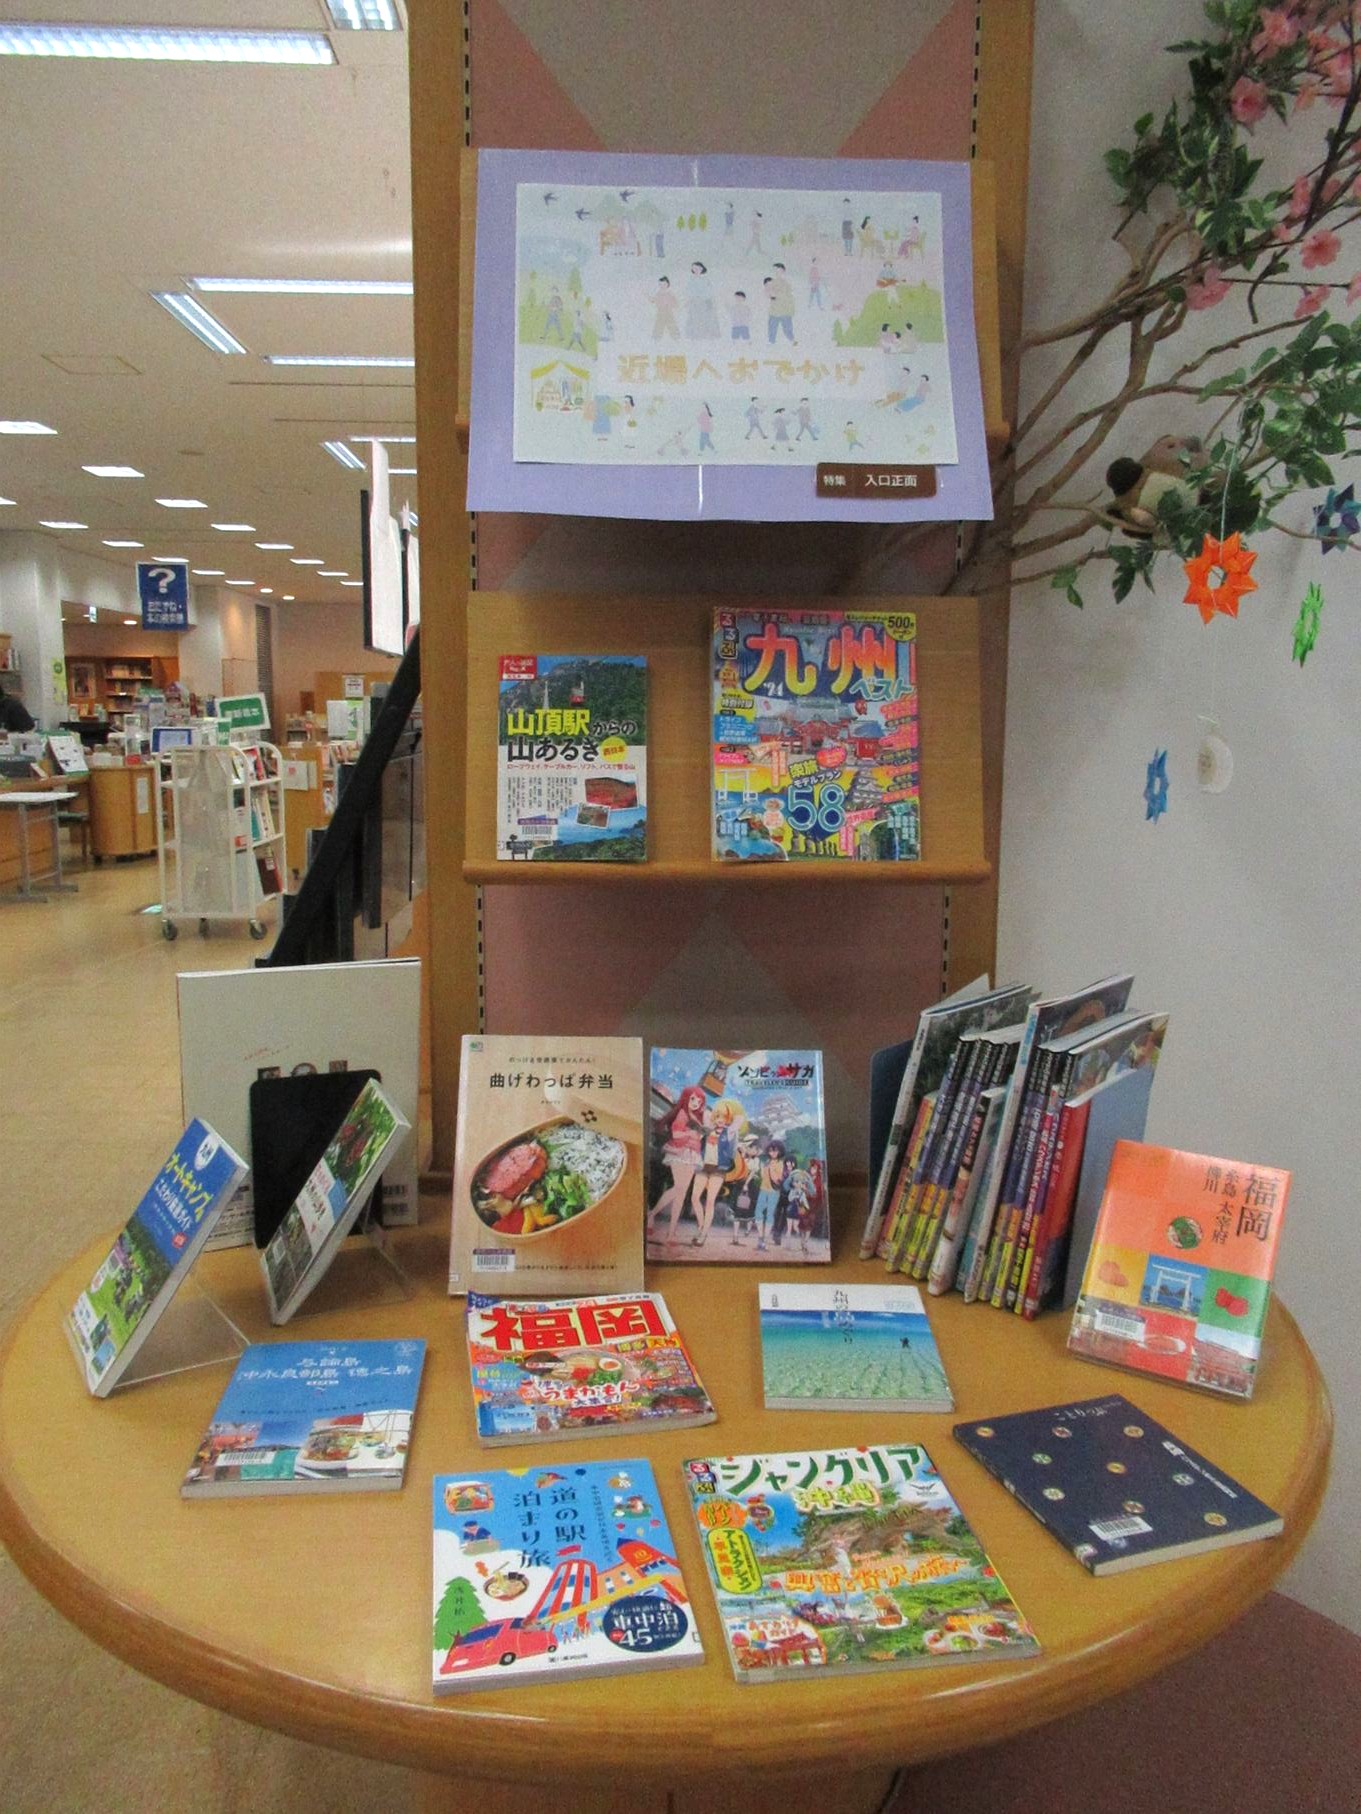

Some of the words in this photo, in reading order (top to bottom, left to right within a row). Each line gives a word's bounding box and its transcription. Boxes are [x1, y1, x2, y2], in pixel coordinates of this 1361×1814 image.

[618, 353, 865, 385] 近場へおでかけ
[823, 475, 847, 486] 特集
[865, 474, 918, 487] 入口正面
[888, 616, 911, 629] 500
[744, 622, 898, 696] 九州
[850, 677, 914, 700] ベスト
[507, 736, 600, 763] 山あるき
[788, 784, 846, 832] 58
[165, 1152, 215, 1223] オートキャンプ
[1221, 1169, 1240, 1198] 糸島
[1237, 1174, 1279, 1242] 福岡
[480, 1299, 668, 1352] 福岡
[544, 1381, 641, 1400] うまかもん
[721, 1448, 922, 1496] ジャングリア
[794, 1482, 878, 1510] 沖縄
[513, 1490, 551, 1568] 泊まり旅
[551, 1486, 588, 1542] 道の駅
[613, 1612, 680, 1631] 車中泊
[619, 1628, 653, 1647] 45
